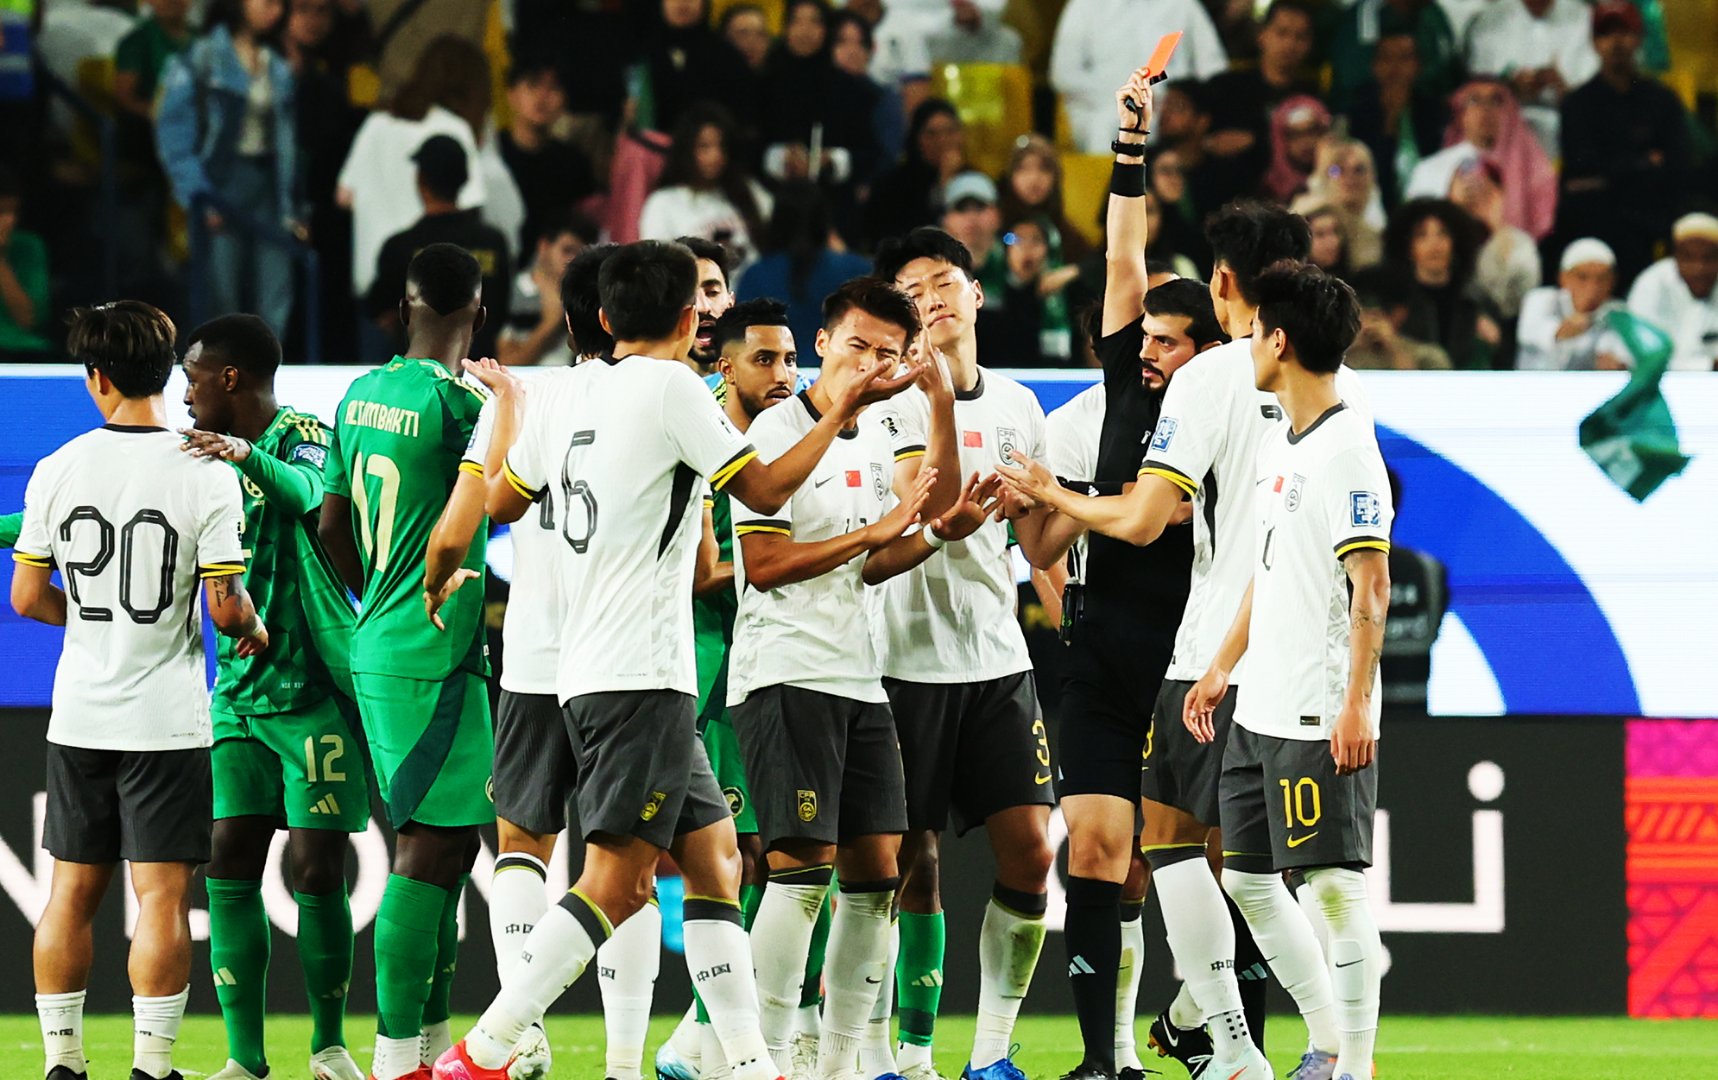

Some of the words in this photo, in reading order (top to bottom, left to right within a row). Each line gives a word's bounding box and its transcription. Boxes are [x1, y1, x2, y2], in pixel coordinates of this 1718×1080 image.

[352, 451, 400, 573] 17
[561, 430, 597, 554] 6
[60, 506, 178, 624] 20
[304, 735, 346, 782] 12
[1032, 720, 1050, 766] 3
[1280, 777, 1321, 828] 10
[696, 963, 732, 982] 中国
